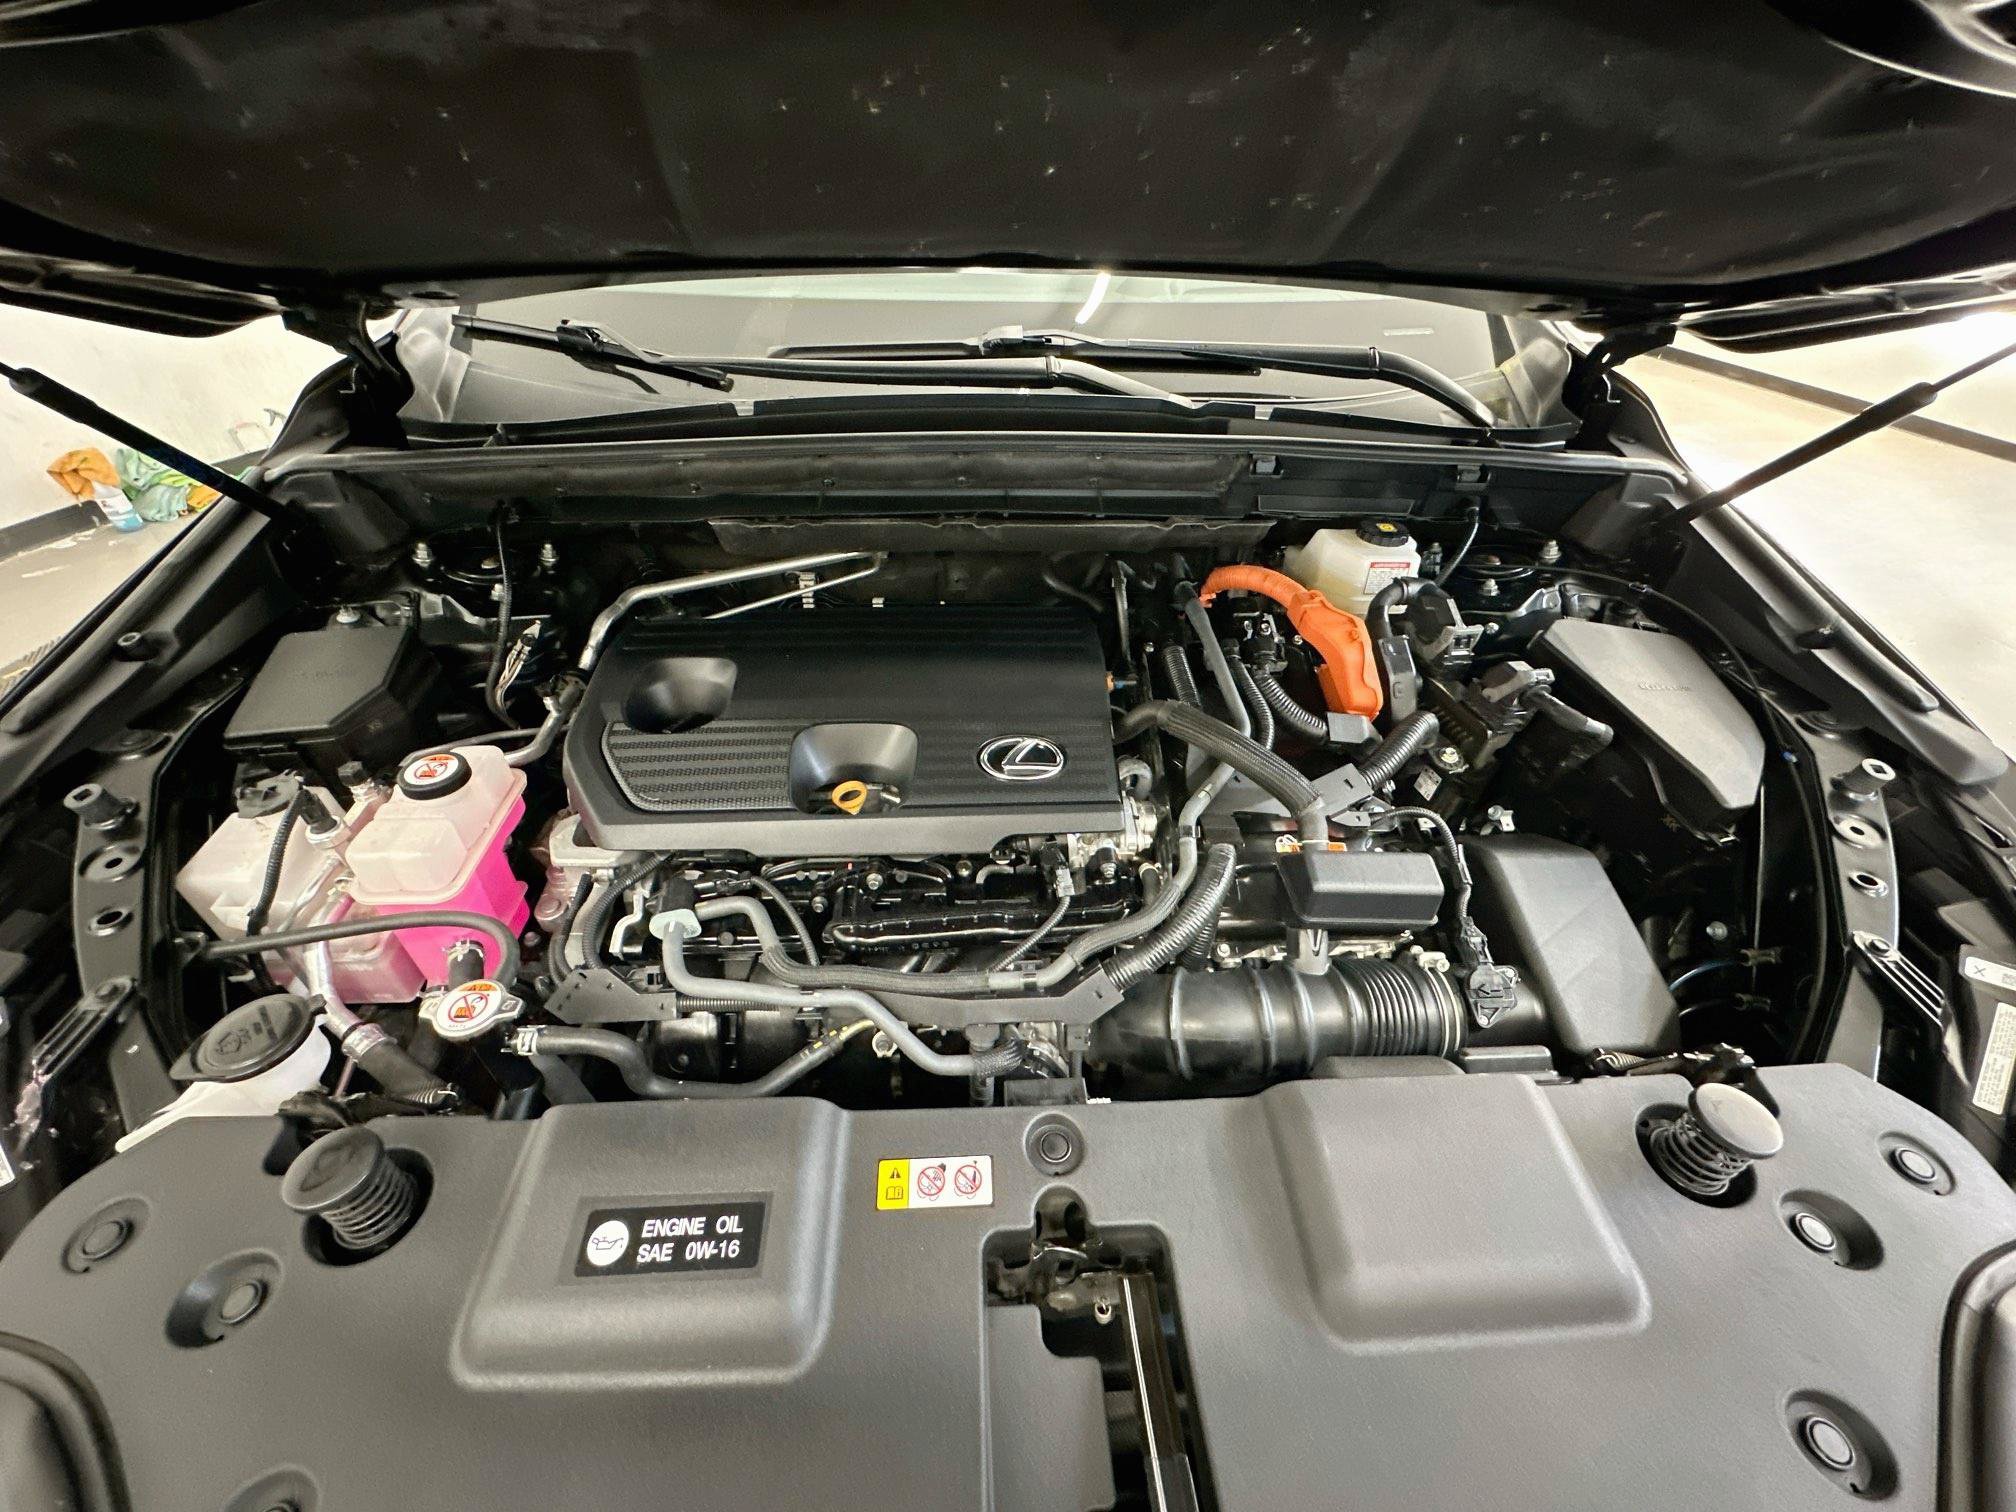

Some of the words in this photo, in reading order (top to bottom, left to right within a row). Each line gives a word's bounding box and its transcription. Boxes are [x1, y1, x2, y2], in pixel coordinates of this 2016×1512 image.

[641, 1216, 706, 1238] ENGINE
[715, 1215, 744, 1234] OIL
[636, 1242, 675, 1263] SAE
[685, 1239, 740, 1261] 0W-16
